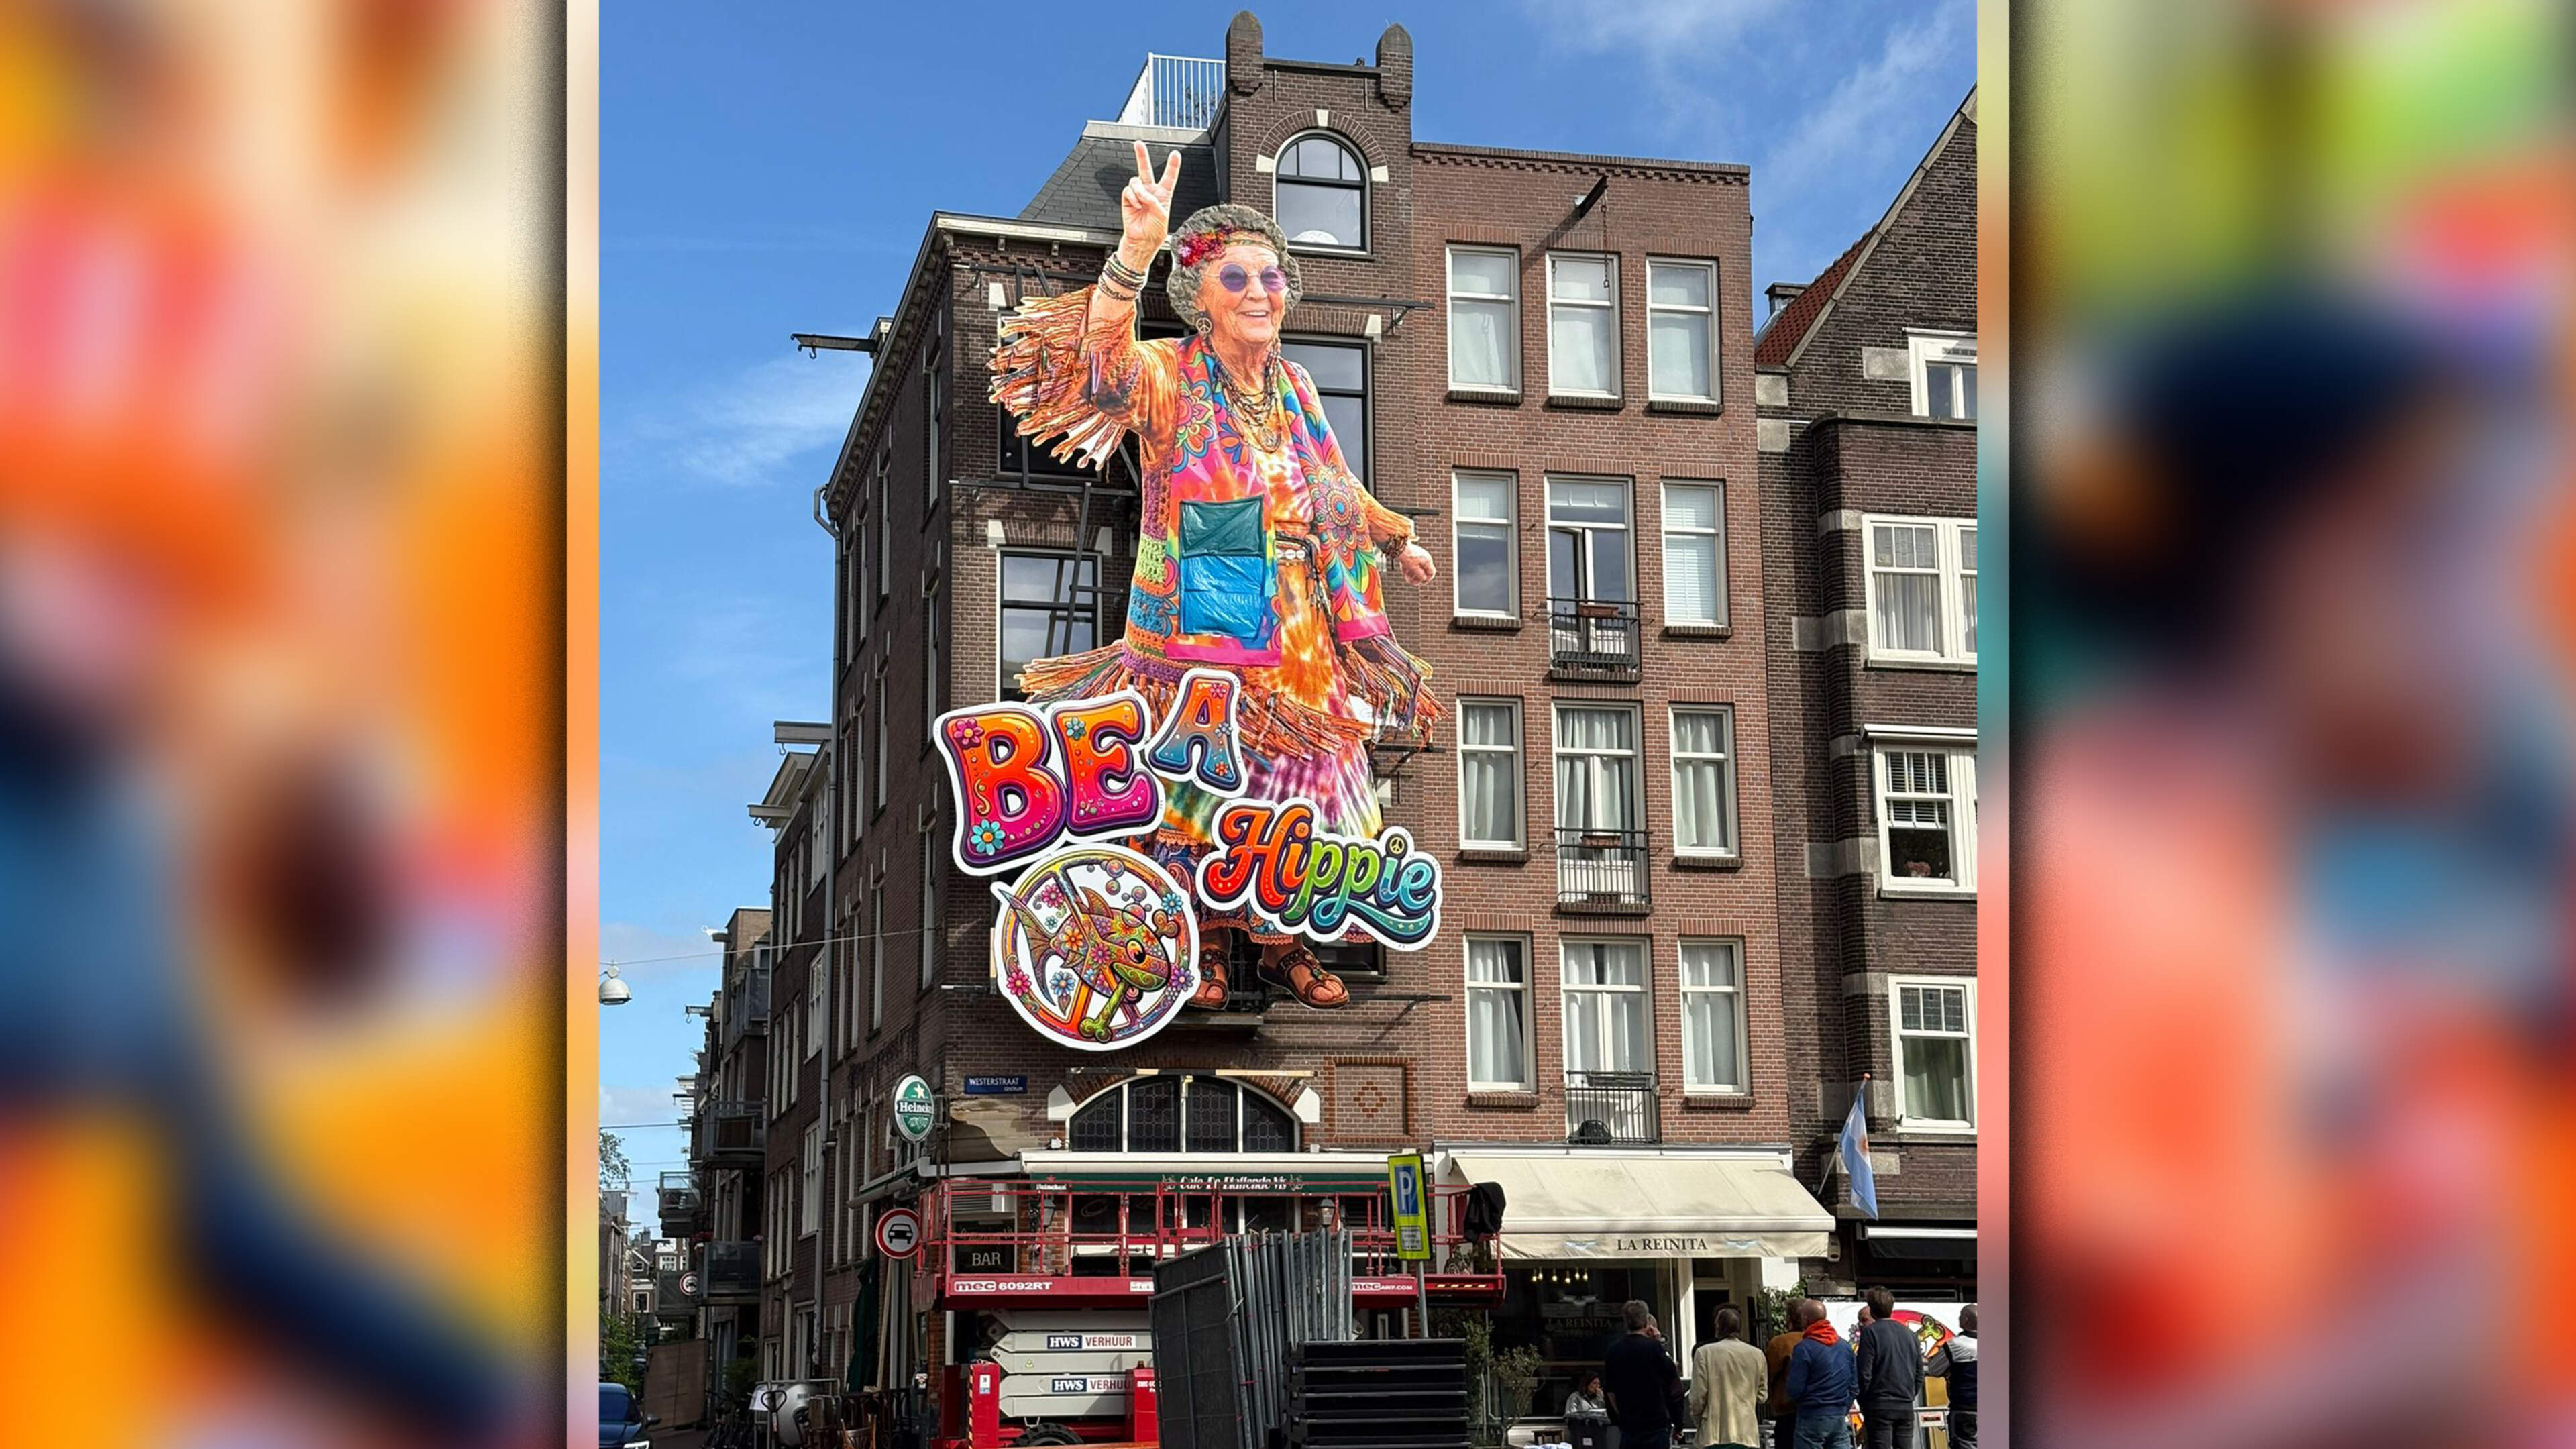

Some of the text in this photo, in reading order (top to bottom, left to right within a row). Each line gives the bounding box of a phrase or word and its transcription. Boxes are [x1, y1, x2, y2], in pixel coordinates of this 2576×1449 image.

[942, 676, 1242, 865] BE A
[1205, 804, 1436, 943] Hippie
[969, 1077, 1019, 1085] WESTERSTRAAT
[899, 1102, 932, 1113] Heinek
[1273, 1175, 1287, 1190] Vis
[1617, 1238, 1708, 1250] LA REINITA
[972, 1252, 1001, 1266] BAR
[955, 1282, 1053, 1291] mec 6092RT
[1049, 1336, 1132, 1348] HWS VERHUUR
[1053, 1380, 1084, 1391] HWS
[1090, 1380, 1133, 1390] VERHUU
